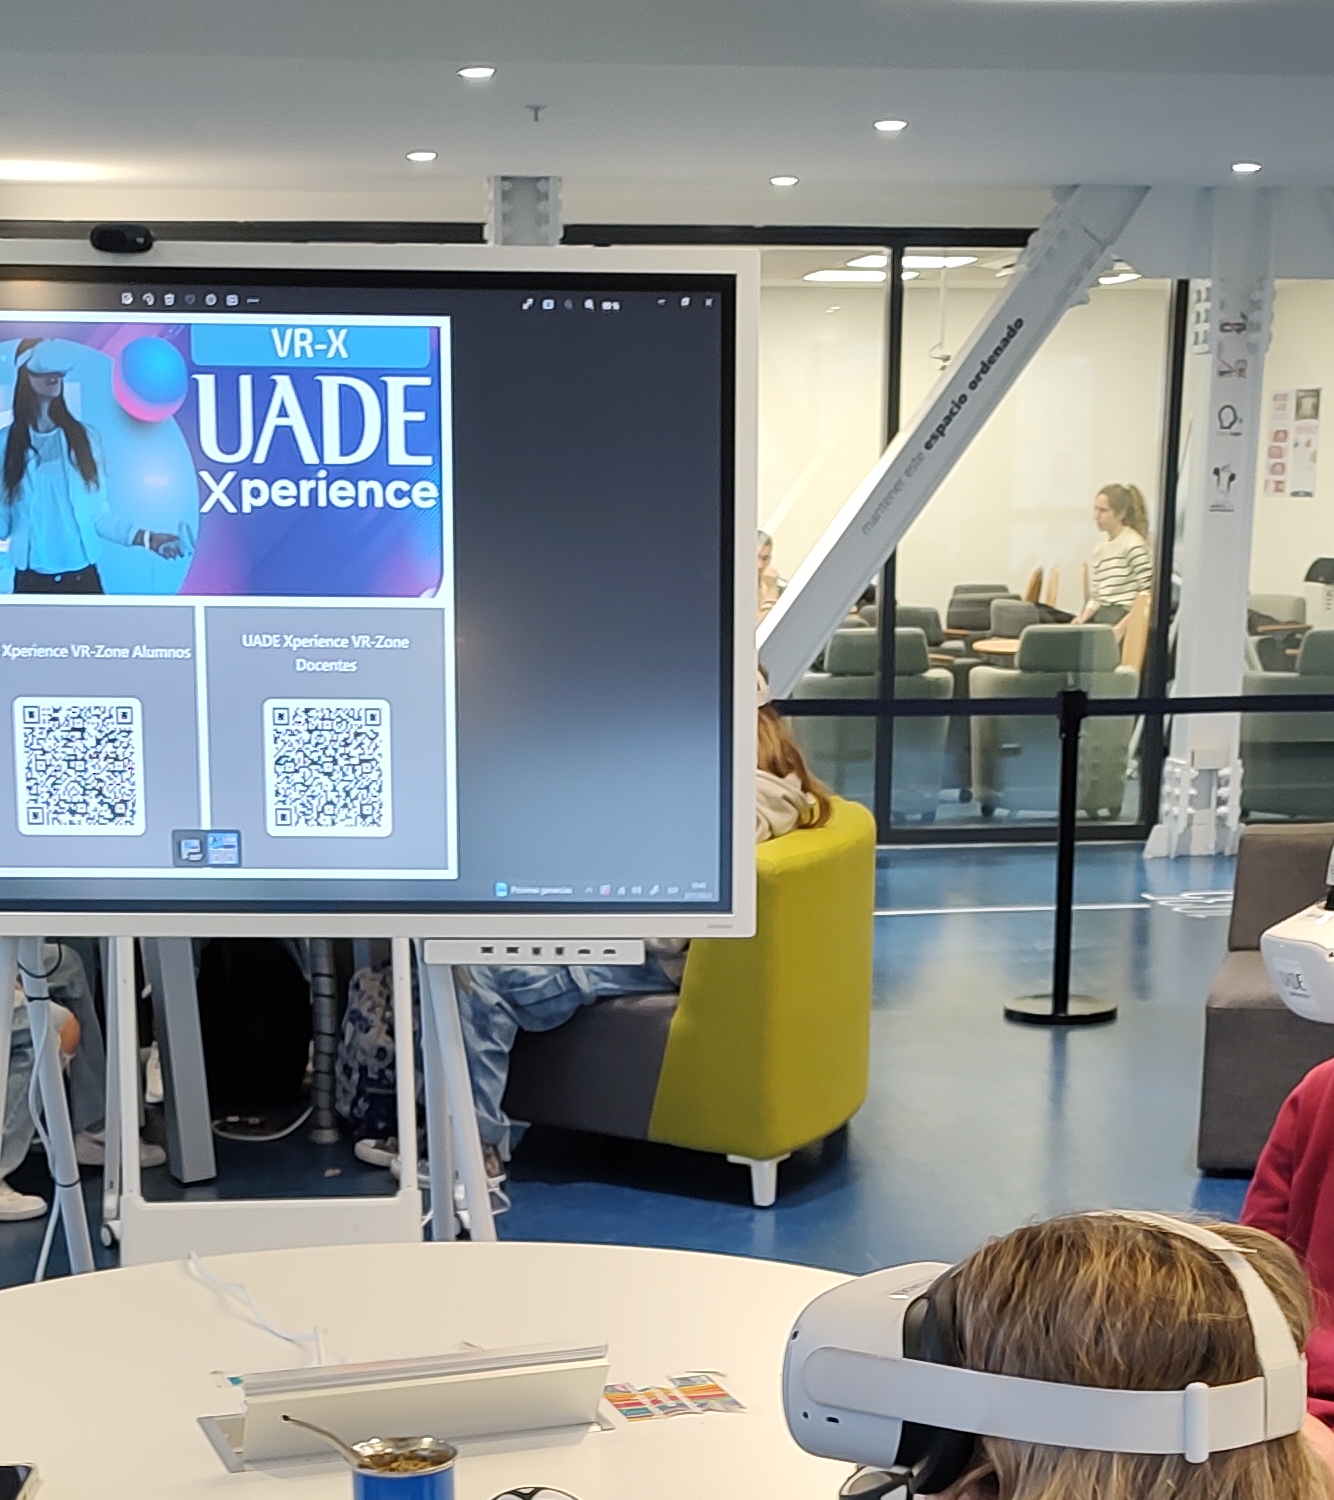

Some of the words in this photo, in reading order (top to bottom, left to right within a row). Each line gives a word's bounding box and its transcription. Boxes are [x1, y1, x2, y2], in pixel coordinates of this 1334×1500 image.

[271, 327, 349, 359] VR-X
[191, 374, 433, 466] UADE
[861, 477, 906, 536] mantener
[903, 451, 926, 479] este
[924, 393, 968, 451] espacio
[968, 317, 1024, 391] ordenado
[198, 469, 439, 514] Xperience
[2, 643, 69, 661] Xperience
[71, 644, 129, 659] VR-Zone
[132, 644, 192, 659] Alumnos
[241, 634, 279, 649] UADE
[281, 633, 349, 651] Xperience
[350, 635, 410, 650] VR-Zone
[295, 657, 357, 673] Docentes
